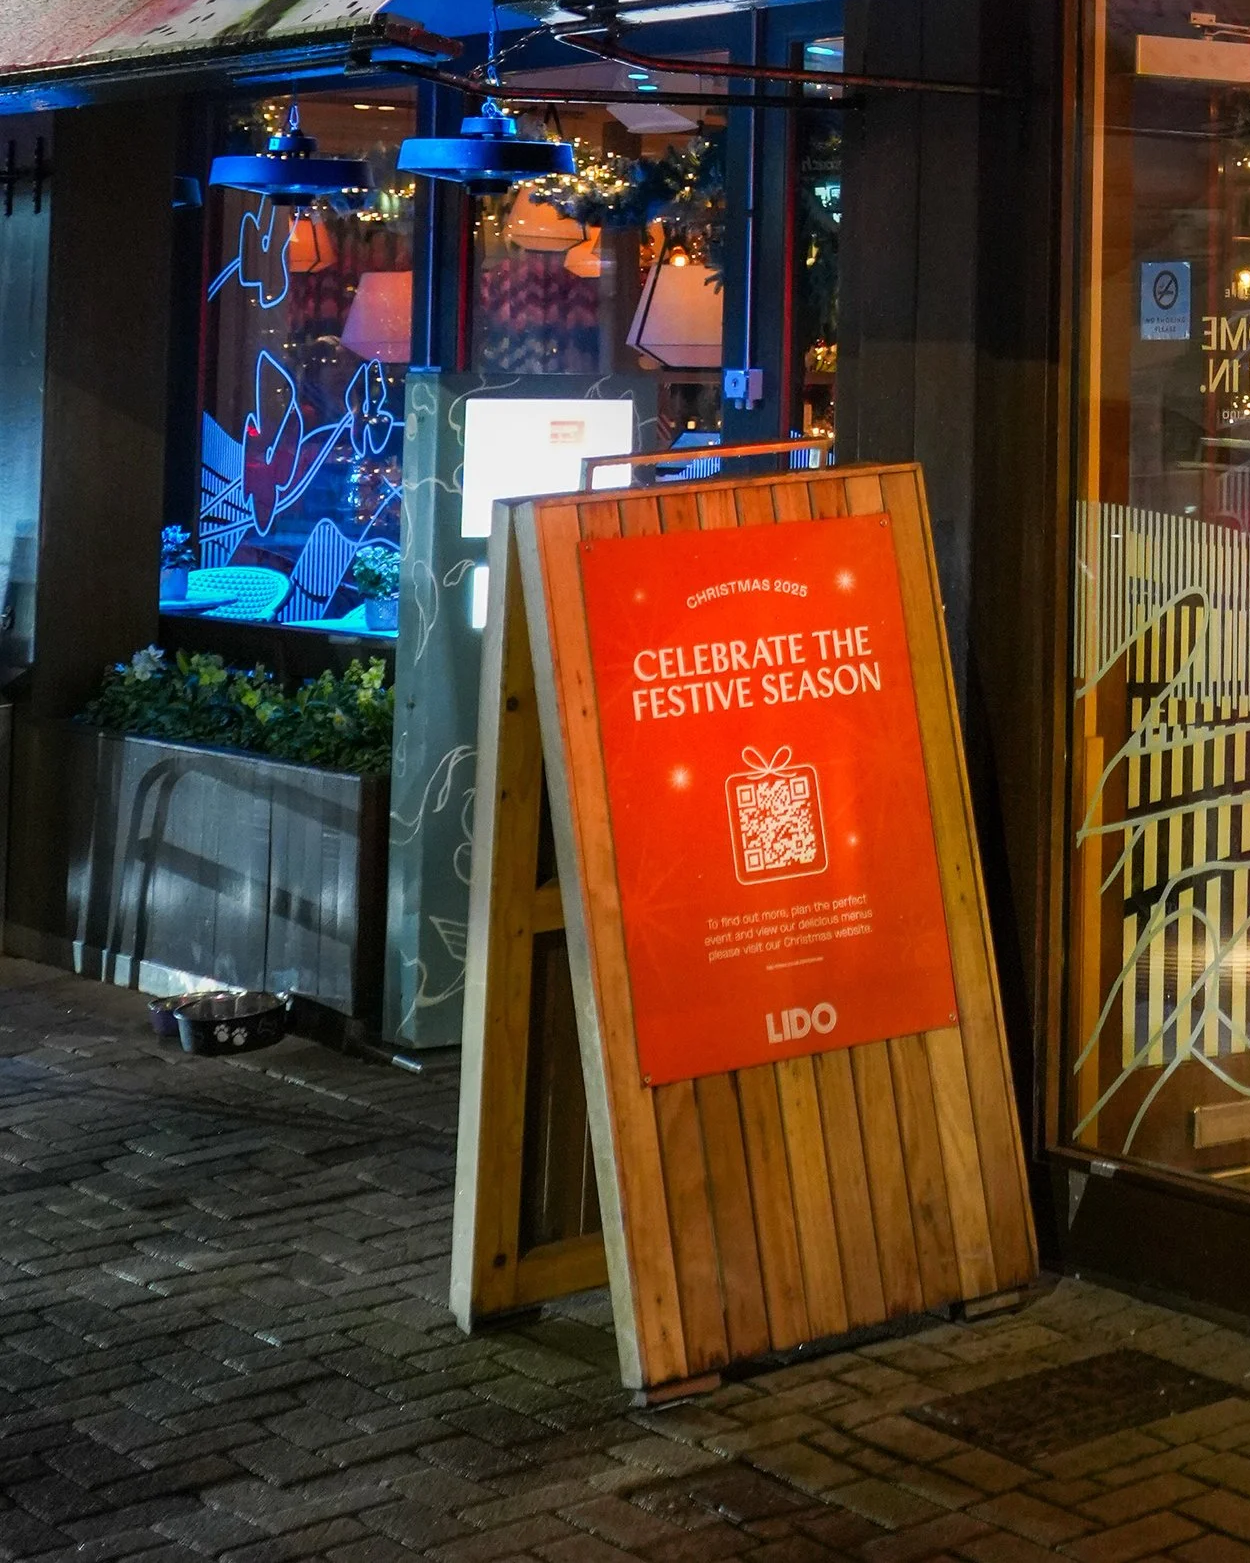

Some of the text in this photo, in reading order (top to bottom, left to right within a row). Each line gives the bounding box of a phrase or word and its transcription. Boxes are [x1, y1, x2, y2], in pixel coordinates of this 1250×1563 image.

[686, 579, 808, 609] CHRISTMAS 2025
[633, 626, 872, 682] CELEBRATE THE
[632, 662, 882, 721] FESTIVE SEASON
[704, 909, 873, 946] event and view our delicious menus
[707, 894, 867, 930] To find out more, plan the perfect
[708, 924, 873, 964] please visit our Christmas website.
[765, 1002, 837, 1046] LIDO
